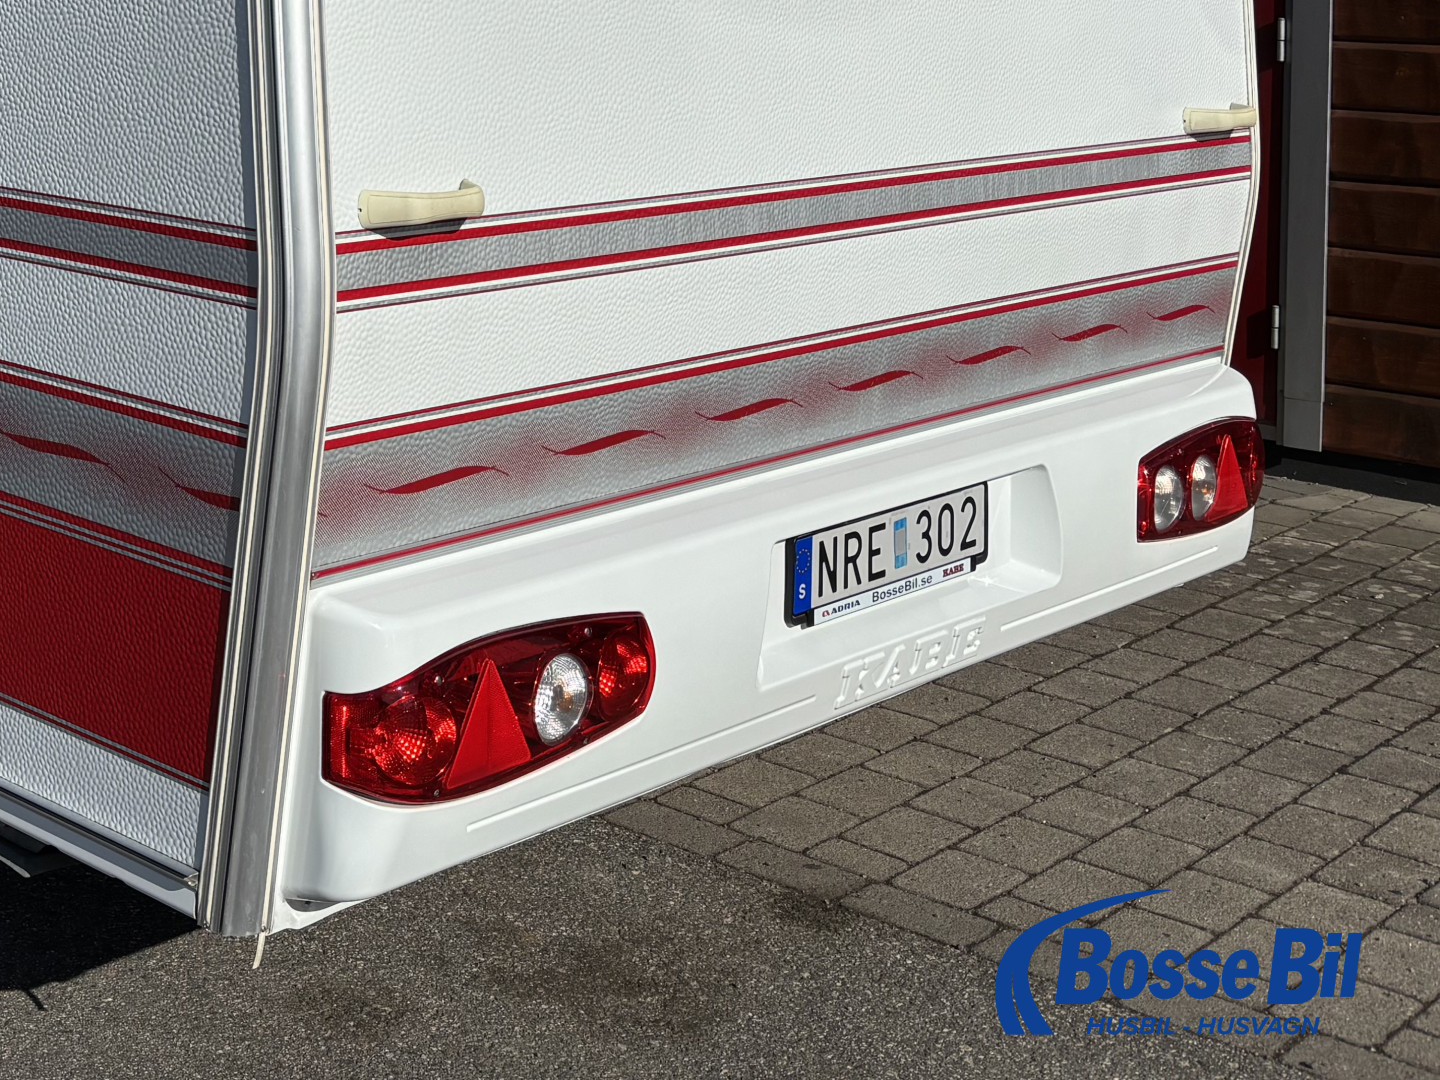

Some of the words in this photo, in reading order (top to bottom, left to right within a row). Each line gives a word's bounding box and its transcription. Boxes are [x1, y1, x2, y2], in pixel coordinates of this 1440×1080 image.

[818, 522, 887, 598] NRE
[915, 496, 977, 564] 302
[798, 583, 806, 600] S
[831, 599, 861, 615] ADRIA
[872, 574, 933, 603] BosseBil.se
